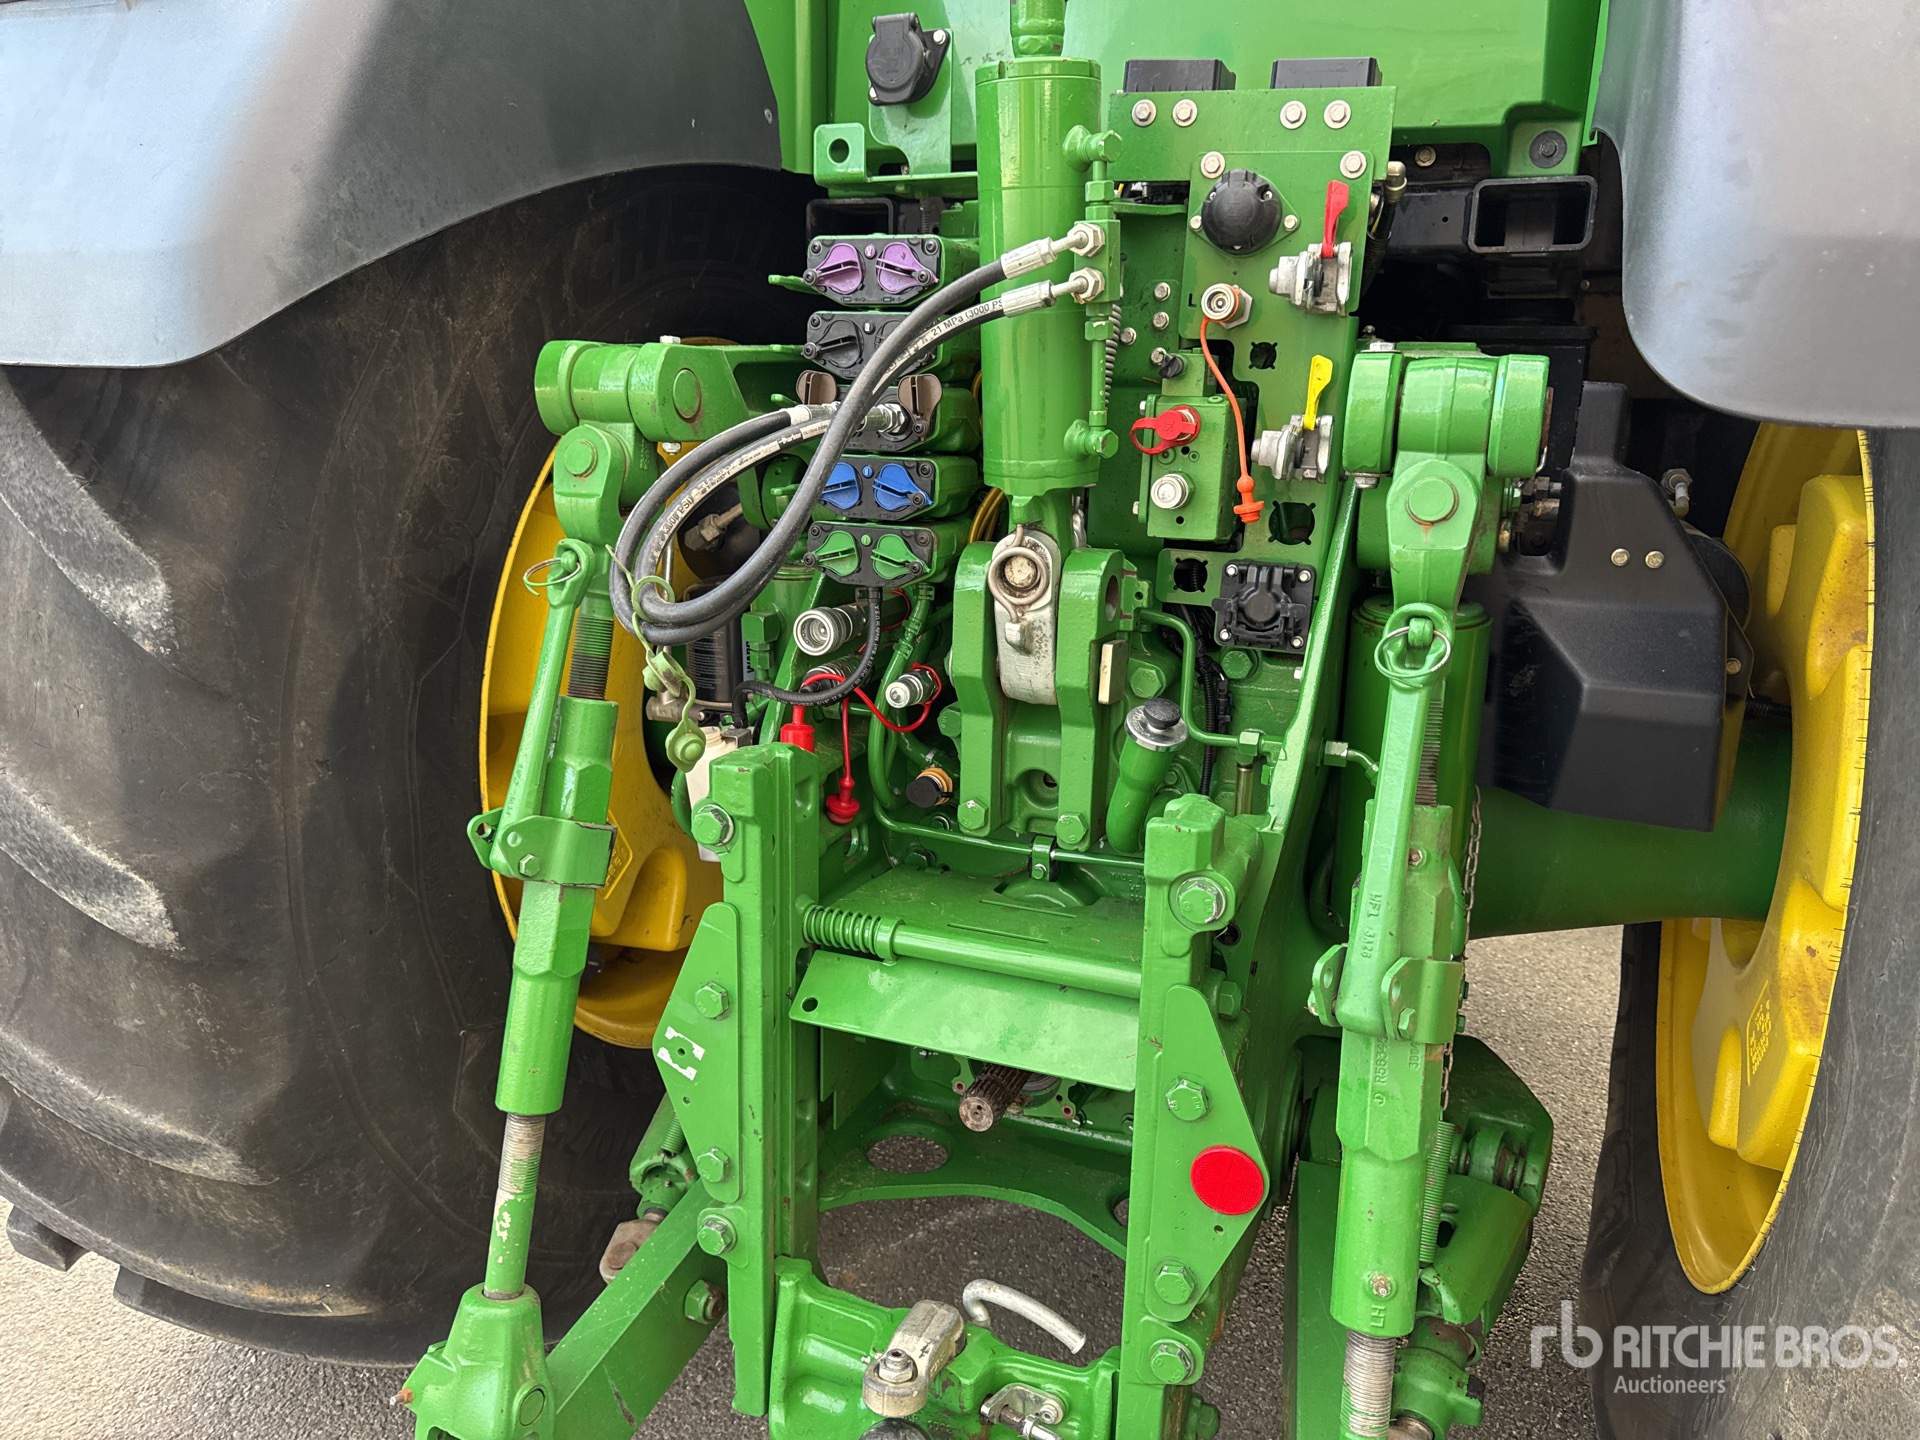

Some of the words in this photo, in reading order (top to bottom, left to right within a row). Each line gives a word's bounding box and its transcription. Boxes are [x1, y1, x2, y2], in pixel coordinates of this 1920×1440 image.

[1188, 293, 1197, 308] L
[930, 325, 943, 338] 21
[944, 315, 965, 330] MPa
[965, 303, 990, 321] (3000
[1370, 1304, 1386, 1329] LH
